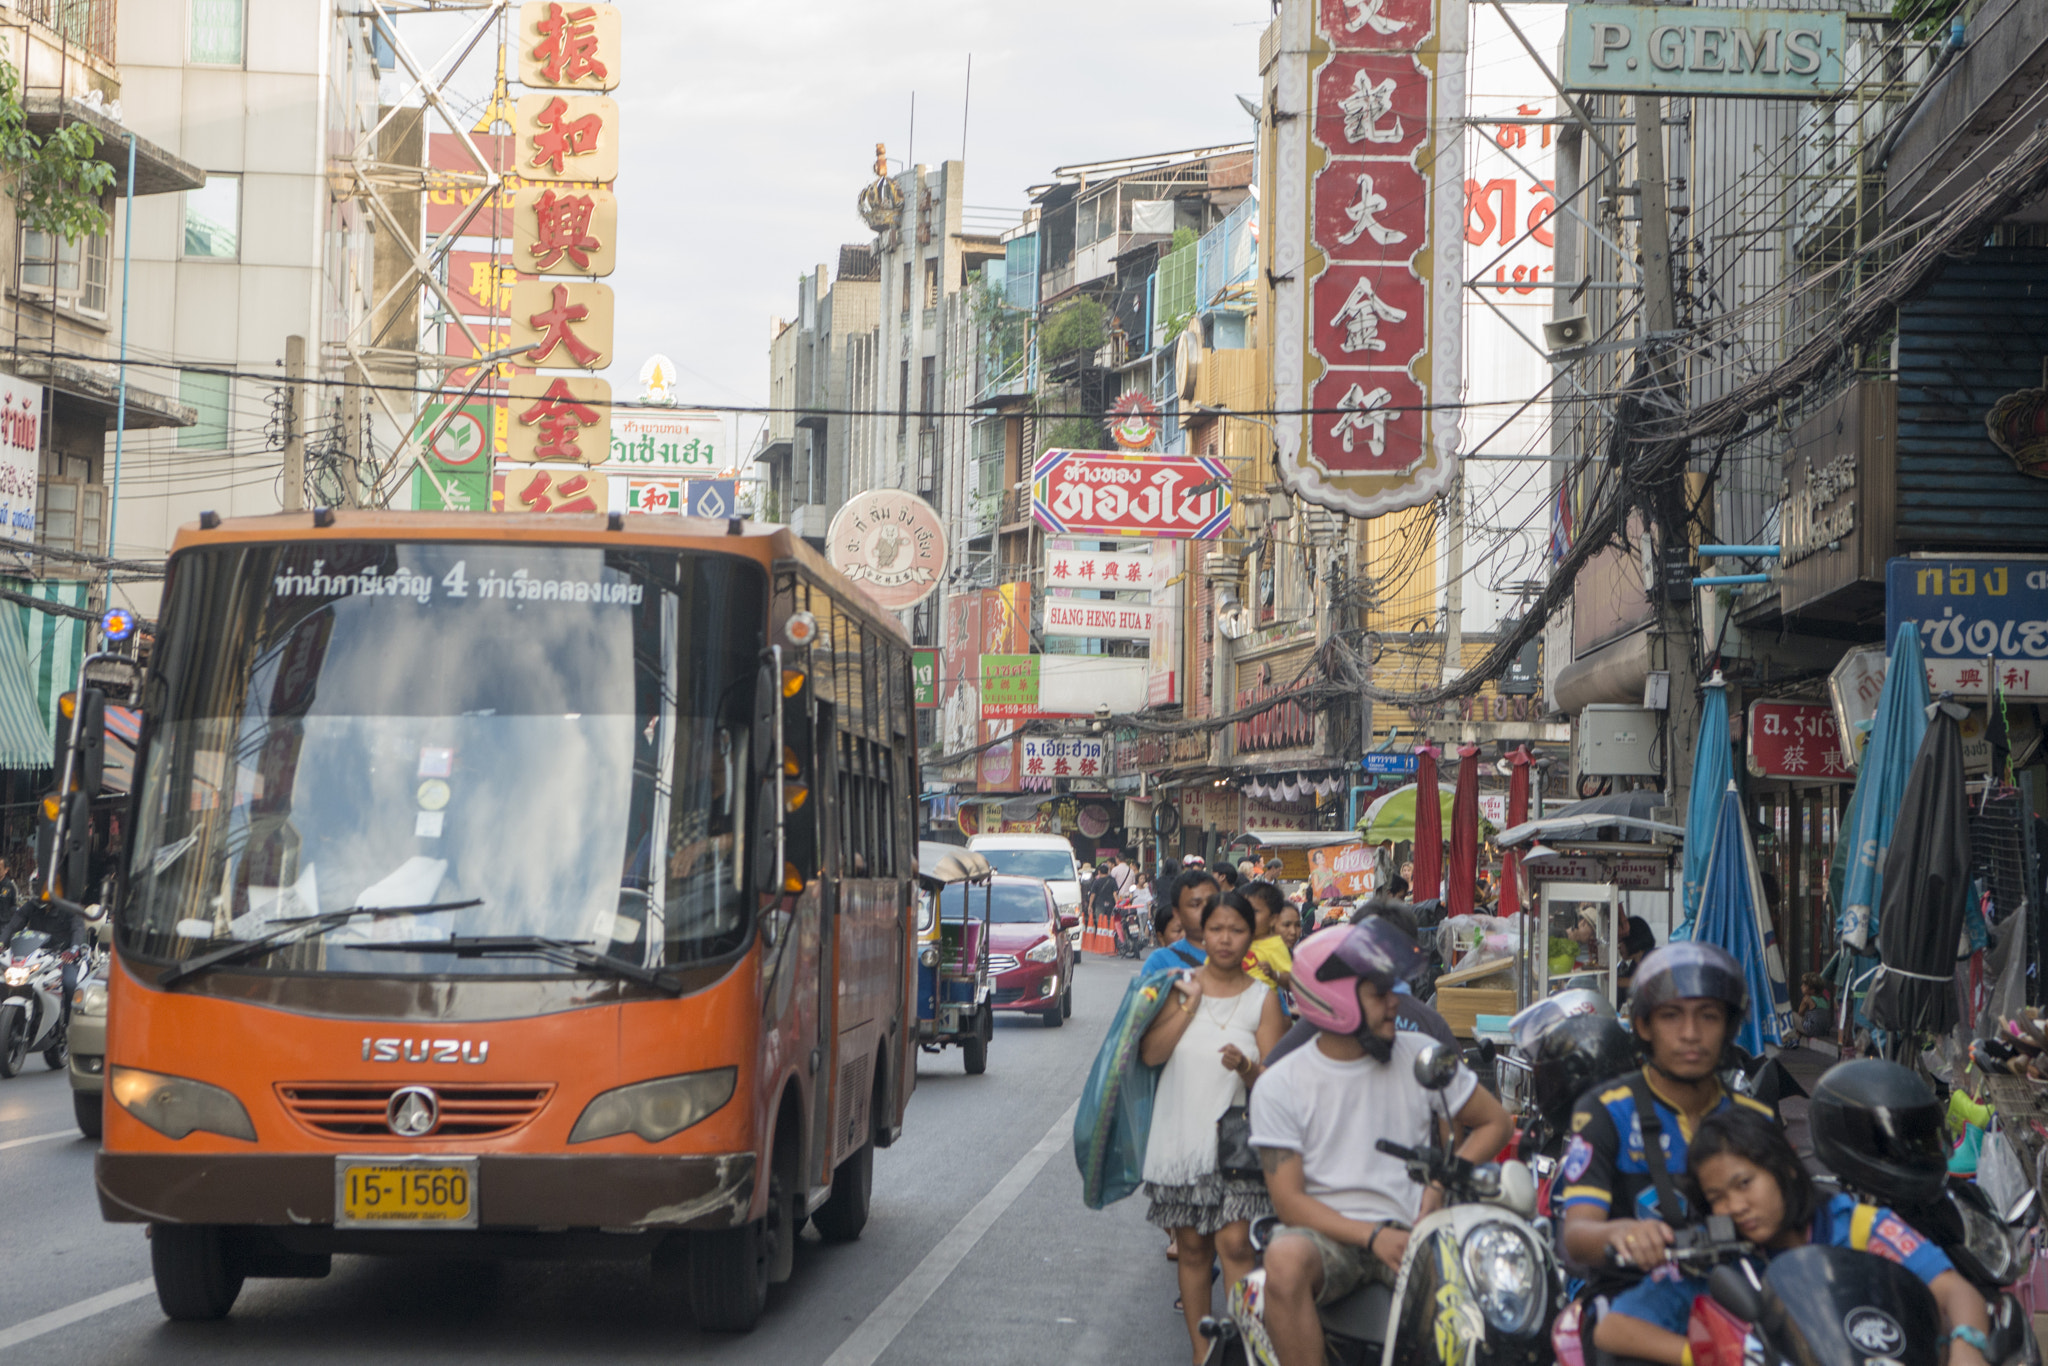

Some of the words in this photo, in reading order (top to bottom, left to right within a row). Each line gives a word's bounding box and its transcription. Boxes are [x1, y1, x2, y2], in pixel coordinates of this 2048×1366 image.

[1063, 459, 1142, 484] ห้างทอง
[642, 487, 669, 512] 和
[1052, 467, 1213, 526] ทองใบ
[274, 560, 432, 604] ท่าน้ำภาษีเจริญ
[441, 560, 469, 598] 4
[476, 569, 644, 606] ท่าเรือคลองเตย
[1915, 567, 2008, 596] ทอง
[1050, 607, 1084, 626] SIANG
[1086, 608, 1117, 629] HENG
[1119, 612, 1143, 630] HUA
[361, 1037, 489, 1065] ISUZU
[351, 1173, 468, 1207] 15-1560
